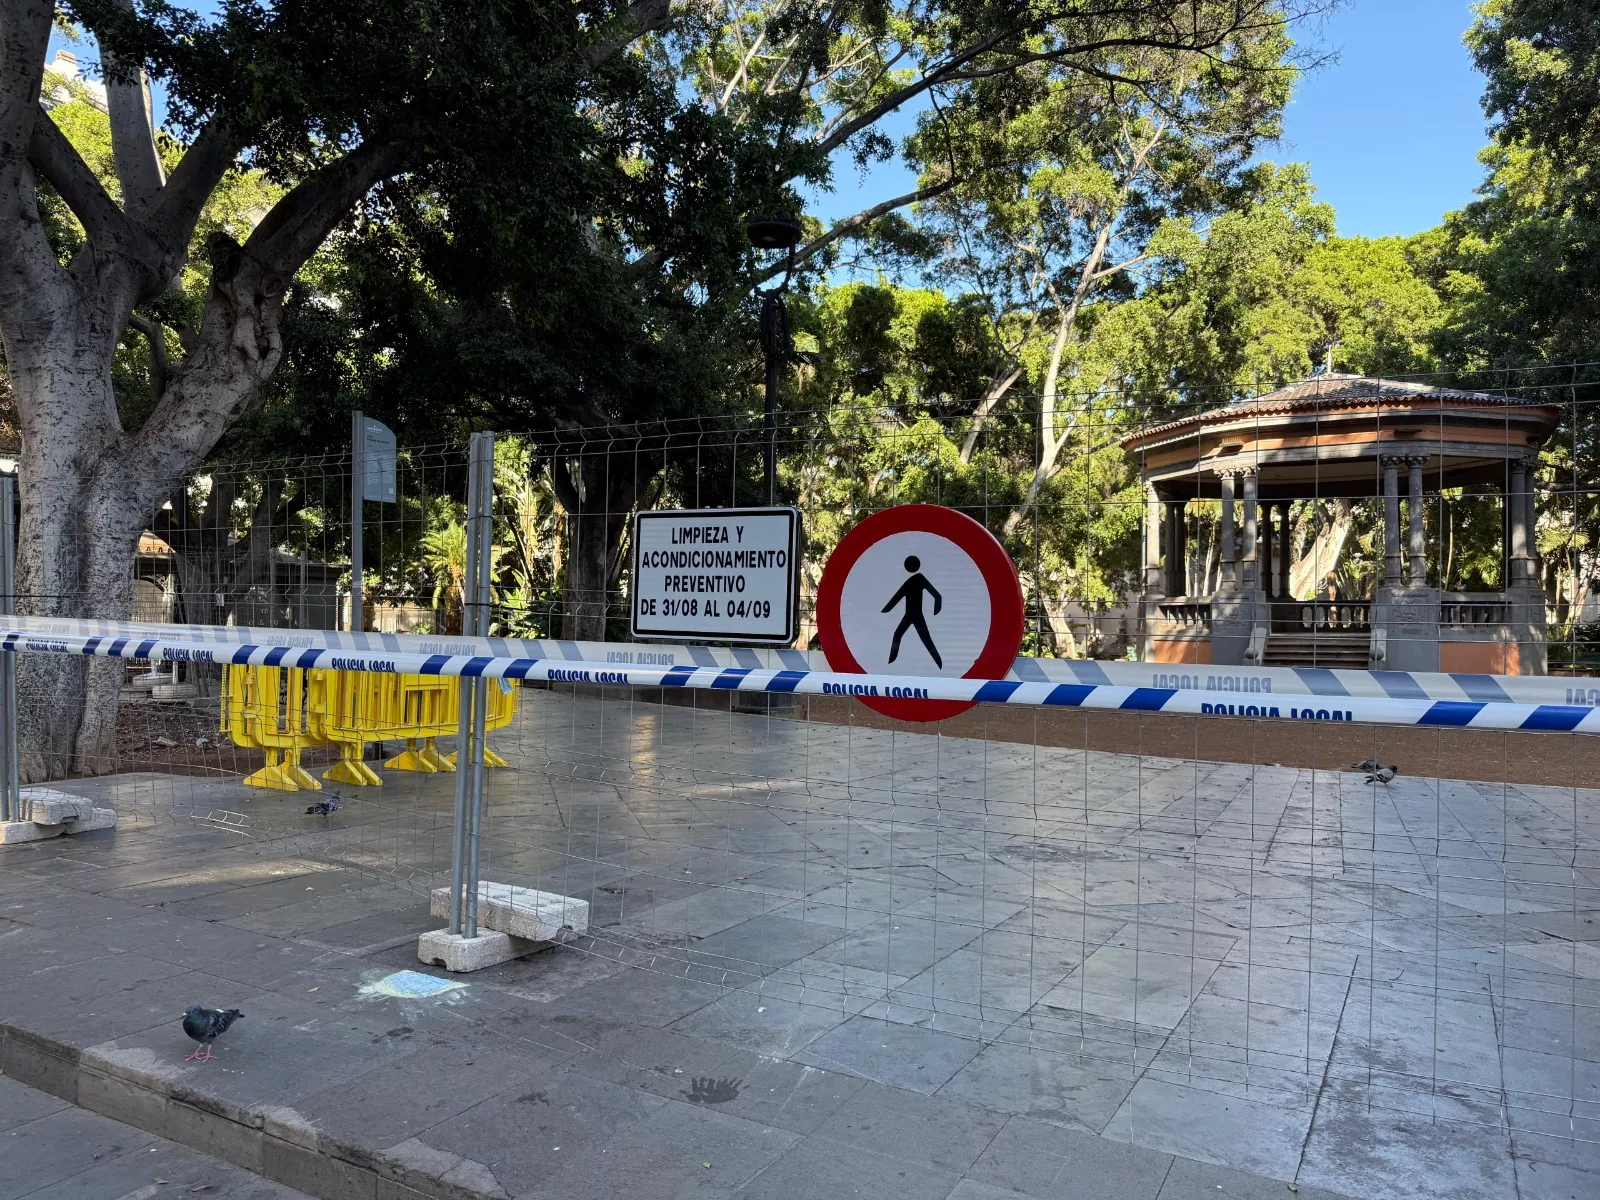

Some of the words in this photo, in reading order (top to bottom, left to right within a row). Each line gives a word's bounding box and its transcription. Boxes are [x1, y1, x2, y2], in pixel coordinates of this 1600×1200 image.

[671, 526, 729, 545] LIMPIEZA
[736, 525, 745, 544] Y
[642, 550, 786, 569] ACONDICIONAMIENTO
[664, 575, 746, 593] PREVENTIVO
[640, 598, 657, 616] DE
[662, 599, 698, 617] 31/08
[704, 600, 720, 618] AL
[727, 600, 771, 619] 04/09
